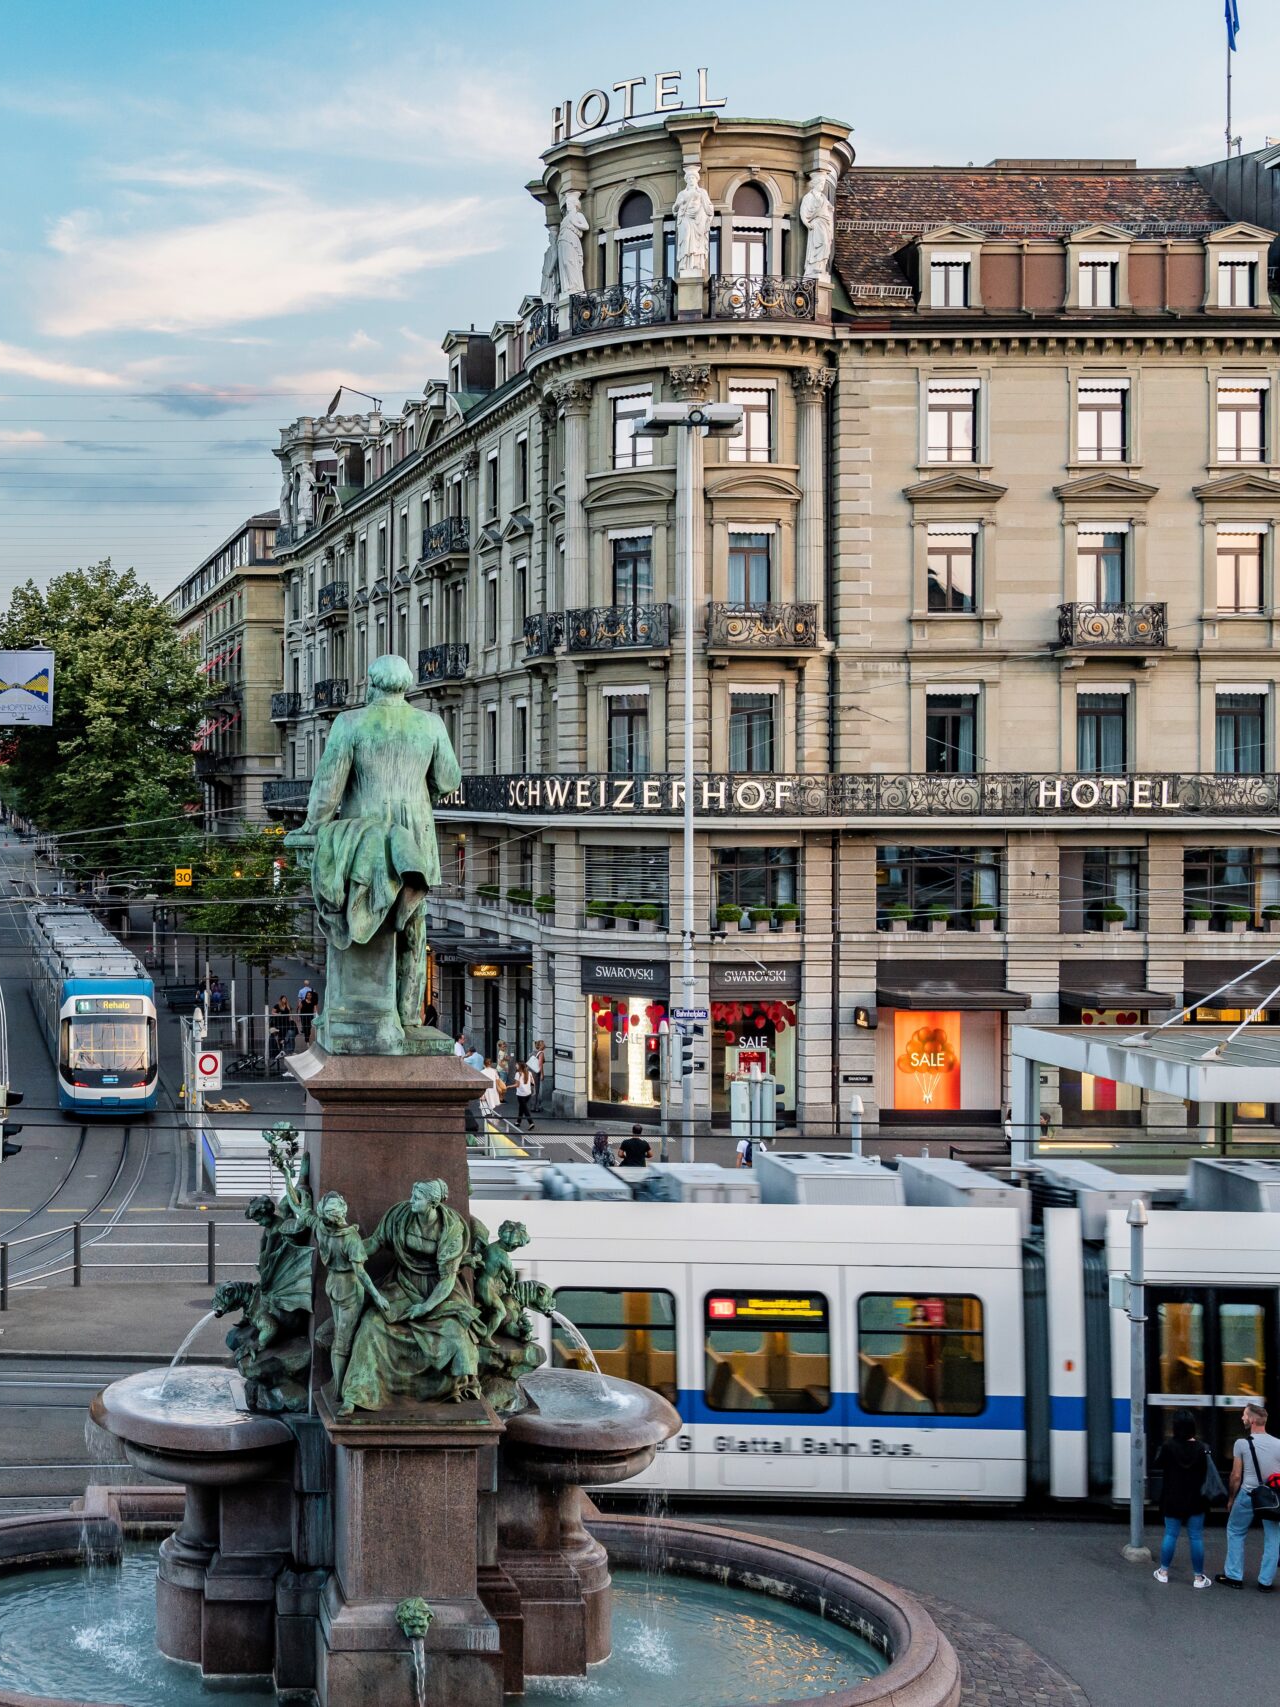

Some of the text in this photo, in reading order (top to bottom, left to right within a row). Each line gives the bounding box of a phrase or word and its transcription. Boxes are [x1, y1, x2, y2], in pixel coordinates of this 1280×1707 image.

[551, 67, 728, 145] HOTEL
[508, 780, 793, 809] SCHWEIZERHOF
[1038, 780, 1181, 808] HOTEL
[176, 872, 191, 882] 30
[595, 965, 654, 981] SWAROVSKI
[724, 969, 786, 983] SWAROVSKI
[79, 1001, 89, 1010] 11
[739, 1036, 768, 1049] SALE
[910, 1052, 945, 1067] SALE
